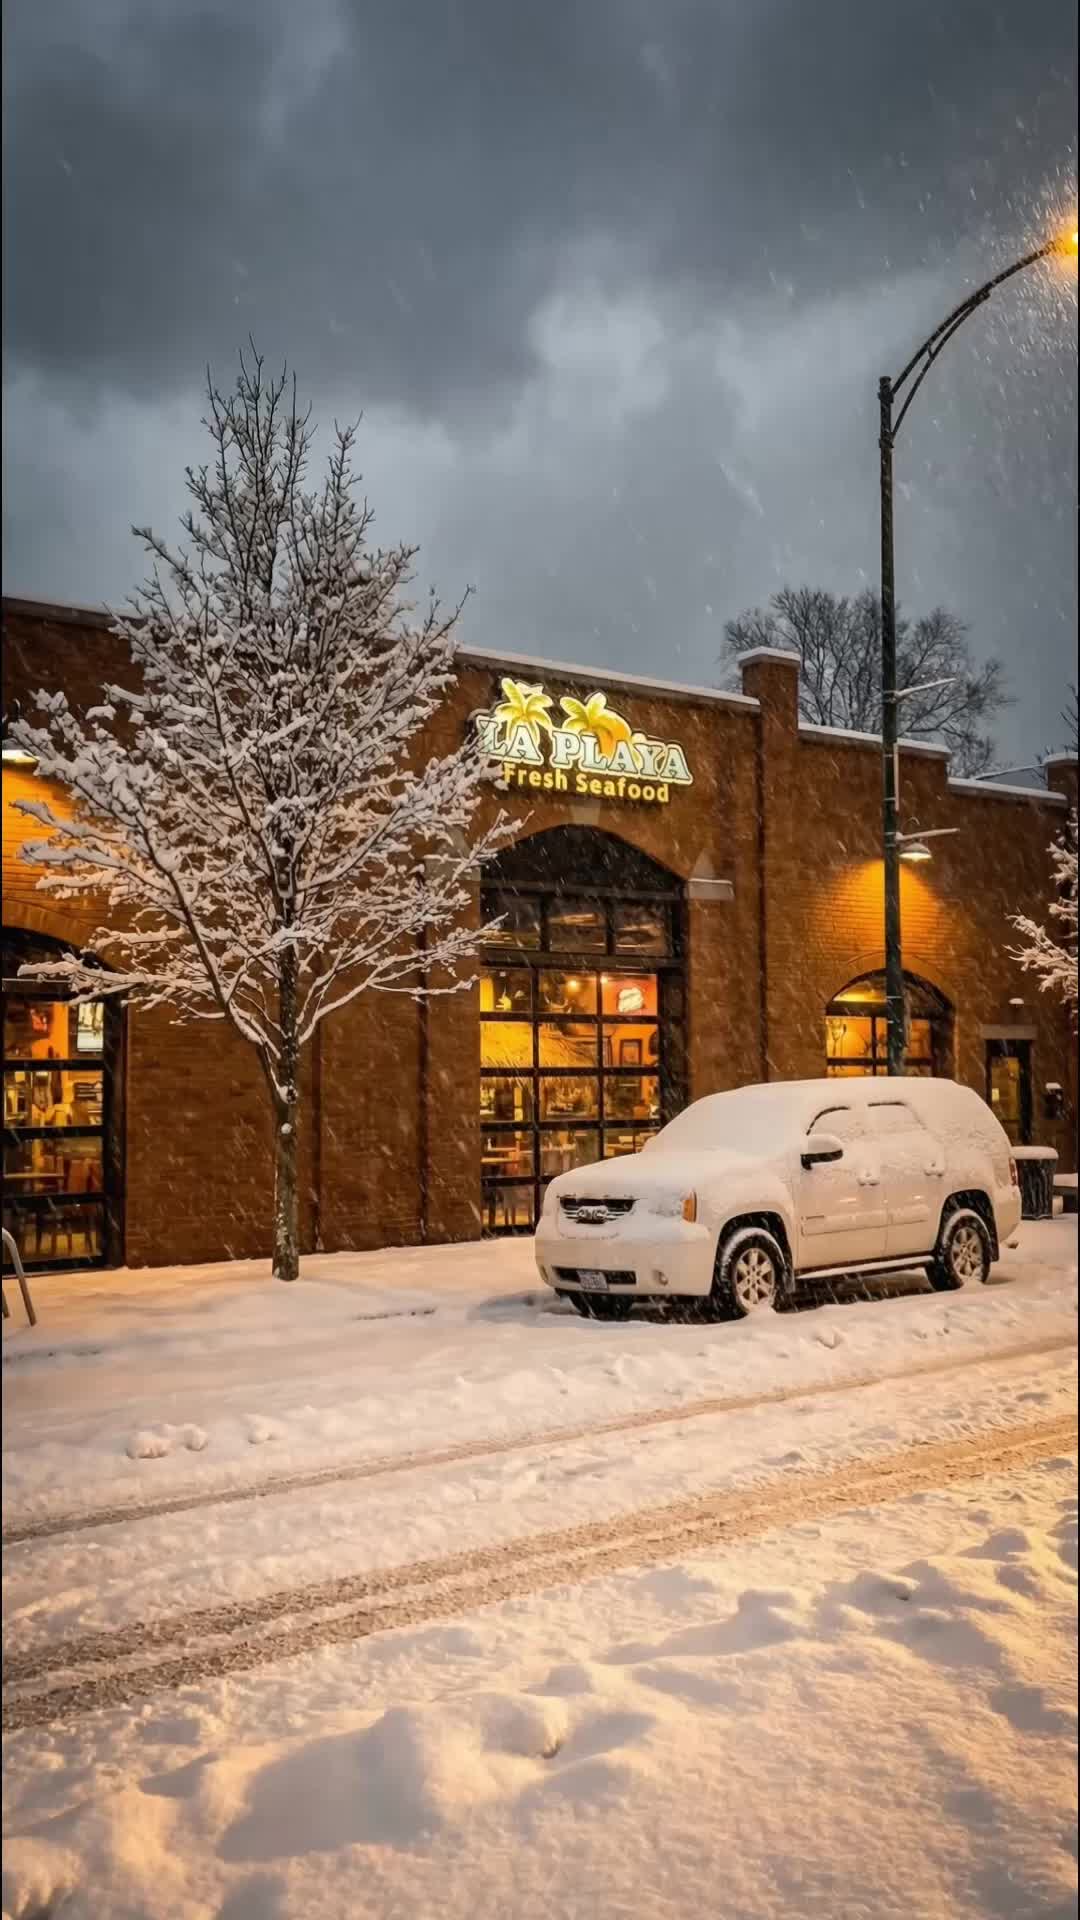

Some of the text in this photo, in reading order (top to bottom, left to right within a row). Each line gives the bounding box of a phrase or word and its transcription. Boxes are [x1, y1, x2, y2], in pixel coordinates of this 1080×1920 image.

[478, 718, 692, 782] LA PLAYA
[503, 762, 670, 802] Fresh Seafood
